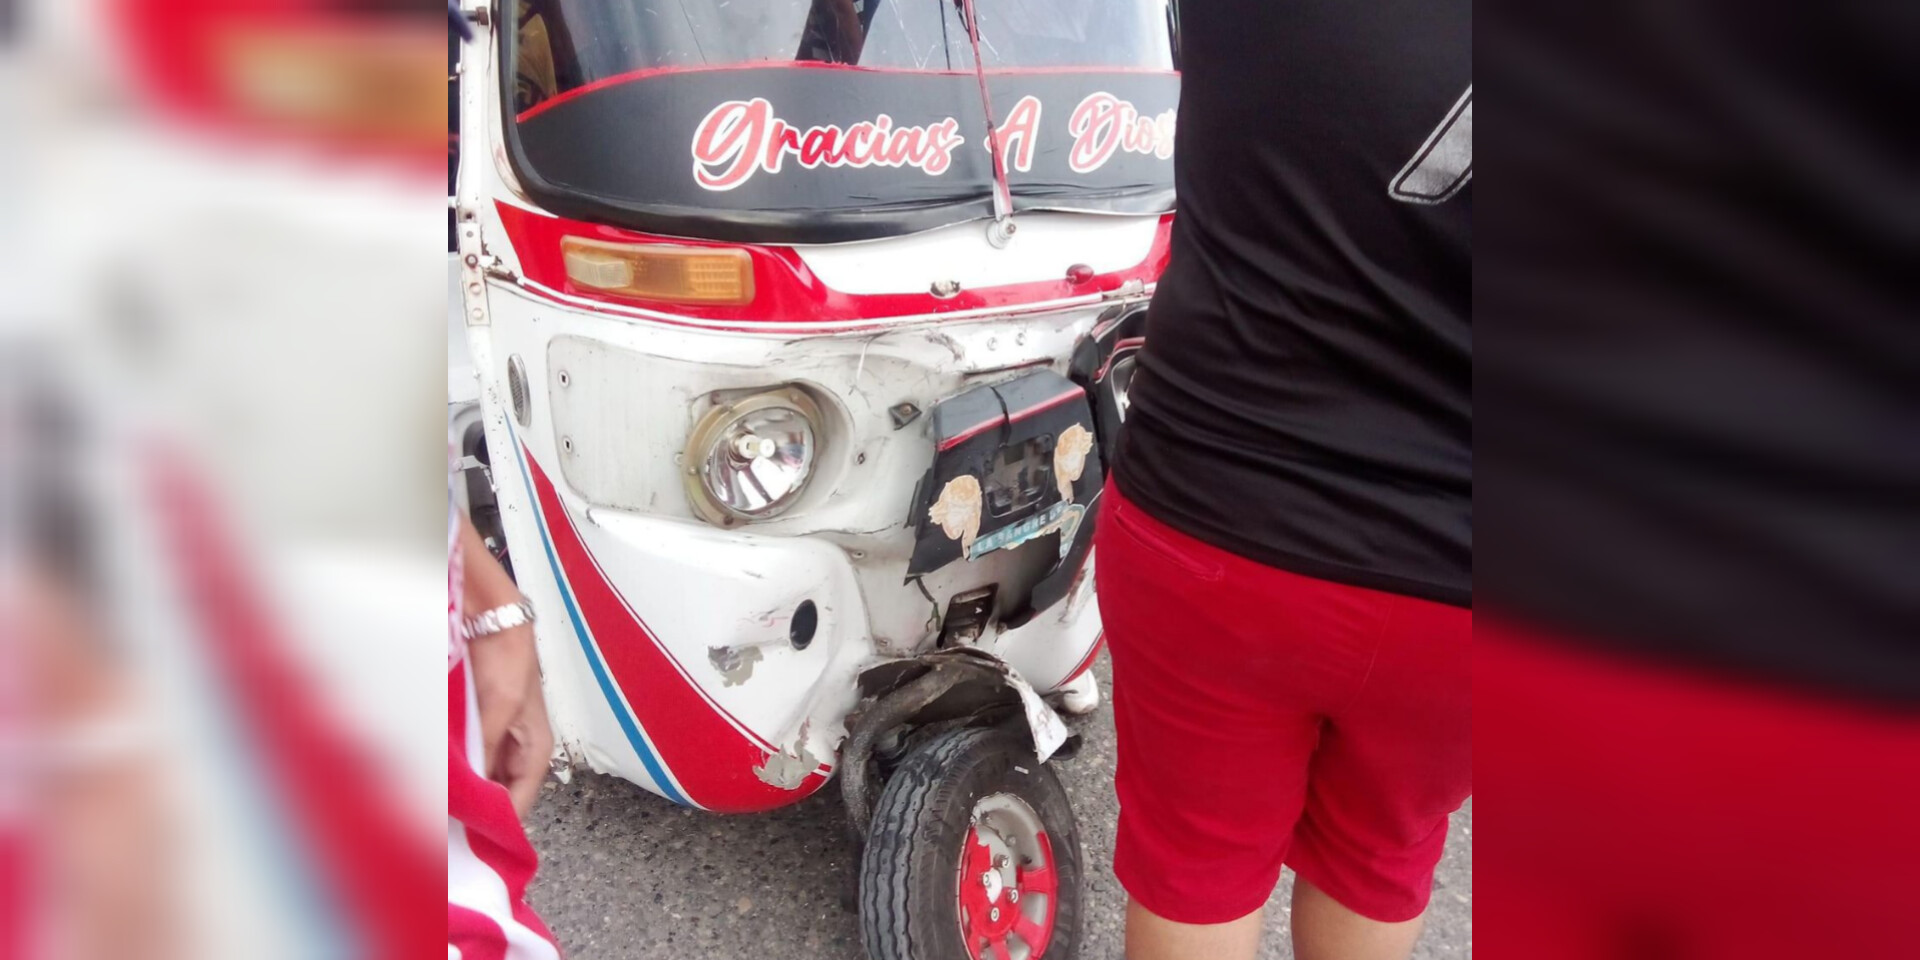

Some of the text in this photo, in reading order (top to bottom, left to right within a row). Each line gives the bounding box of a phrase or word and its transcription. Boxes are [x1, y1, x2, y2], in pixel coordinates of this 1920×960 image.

[692, 92, 1176, 190] Gracias A Dios
[977, 537, 994, 552] LA
[998, 514, 1047, 541] SANGRE
